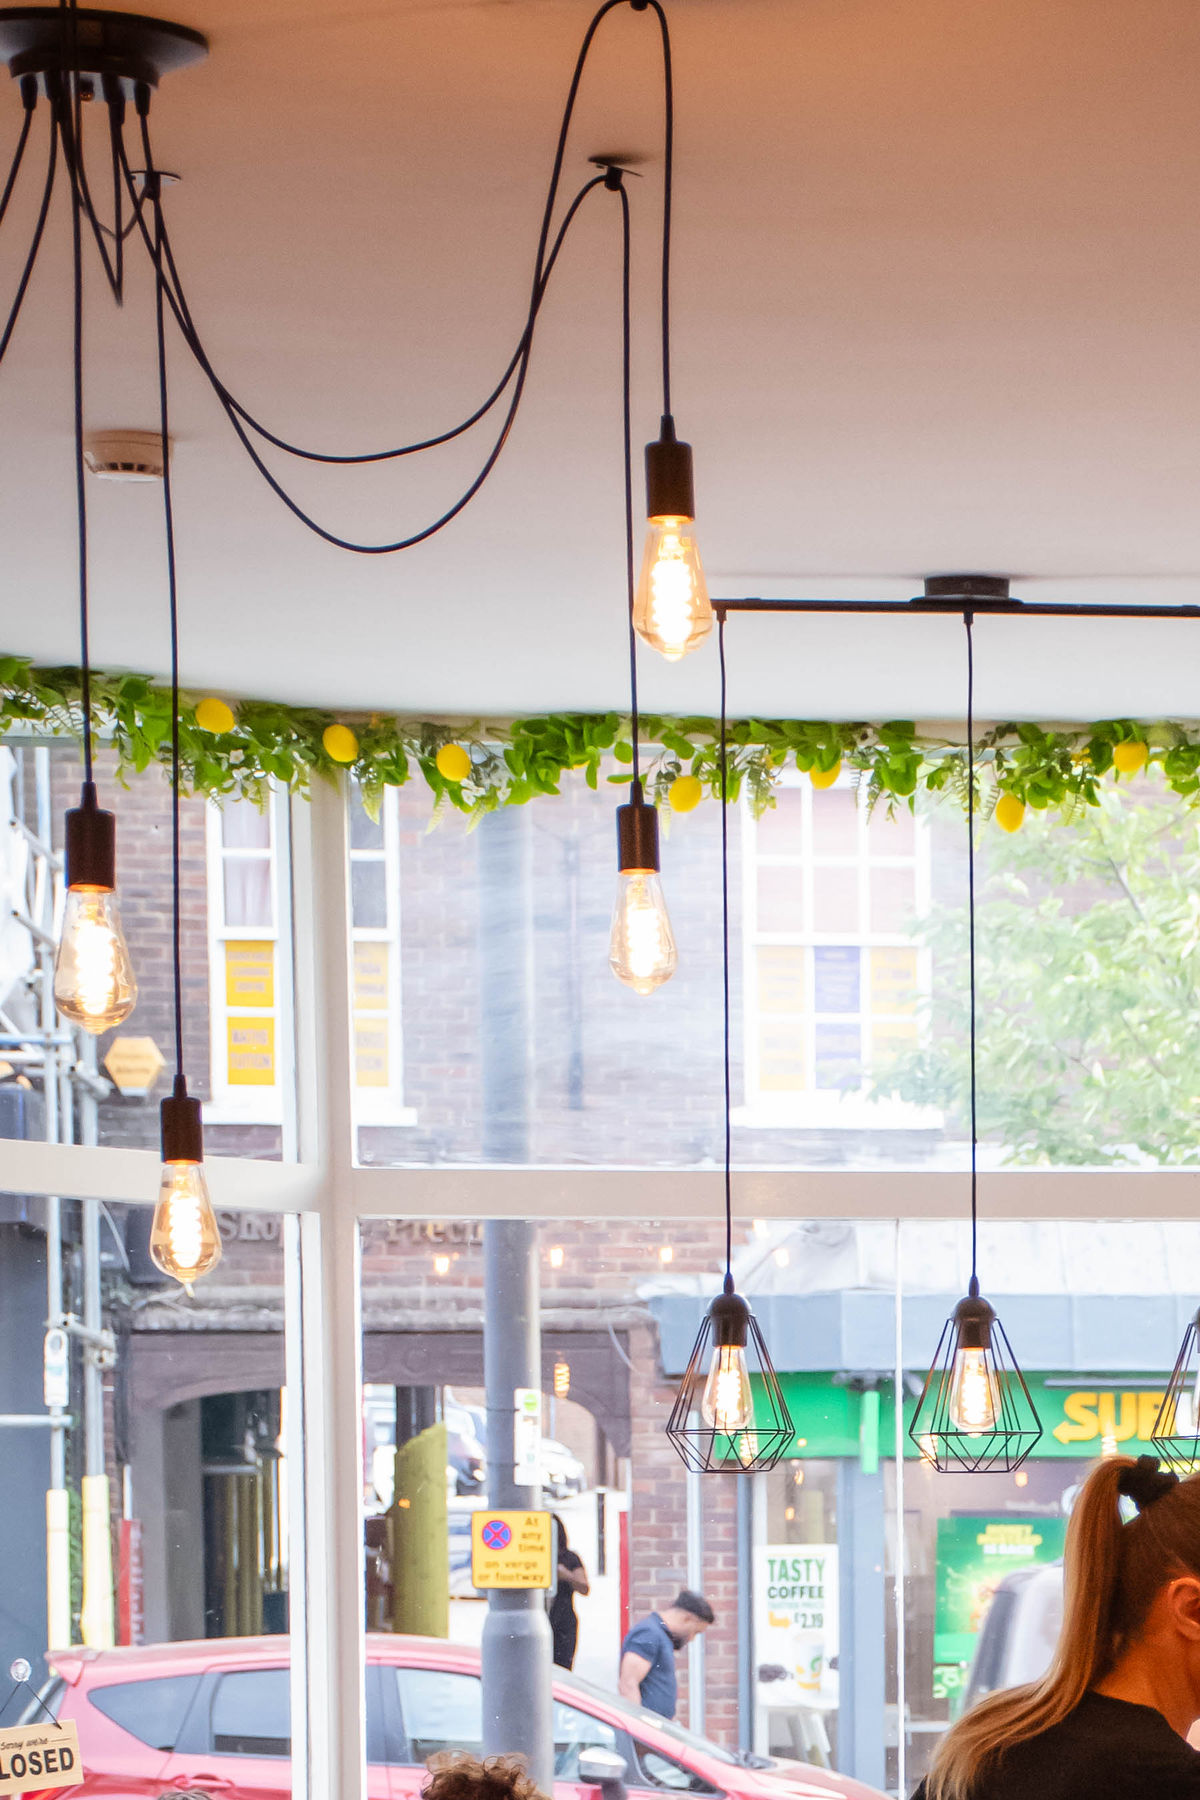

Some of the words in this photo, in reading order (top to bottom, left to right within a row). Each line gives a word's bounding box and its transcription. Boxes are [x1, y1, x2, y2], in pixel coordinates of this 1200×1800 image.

[217, 1211, 280, 1240] Sho
[525, 1516, 538, 1526] At
[521, 1532, 541, 1541] any
[518, 1543, 545, 1552] time
[767, 1559, 825, 1582] TASTY
[767, 1586, 824, 1599] COFFEE
[0, 1747, 74, 1780] LOSED
